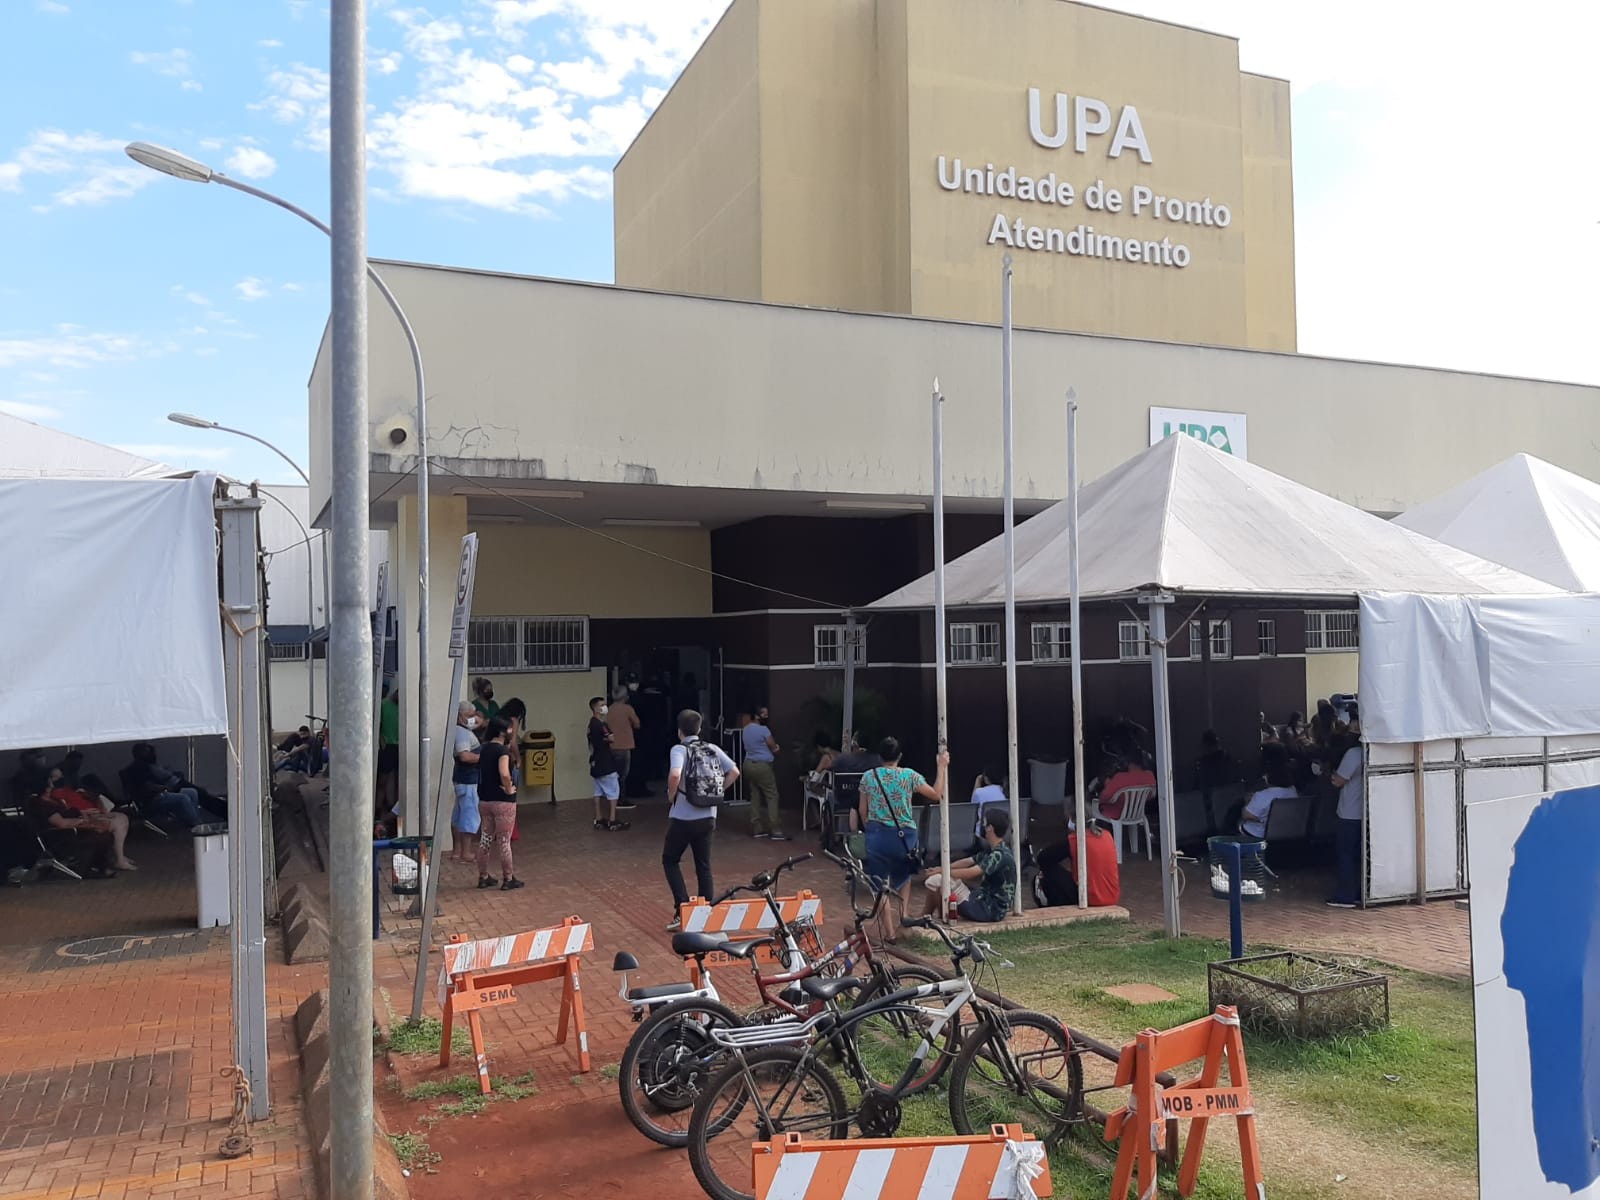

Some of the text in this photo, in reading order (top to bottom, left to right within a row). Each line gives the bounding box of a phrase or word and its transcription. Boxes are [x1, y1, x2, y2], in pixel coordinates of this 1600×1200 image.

[1028, 87, 1153, 163] UPA
[937, 155, 1231, 228] Unidade de Pronto
[987, 213, 1192, 268] Atendimento
[1206, 1094, 1239, 1110] PMM
